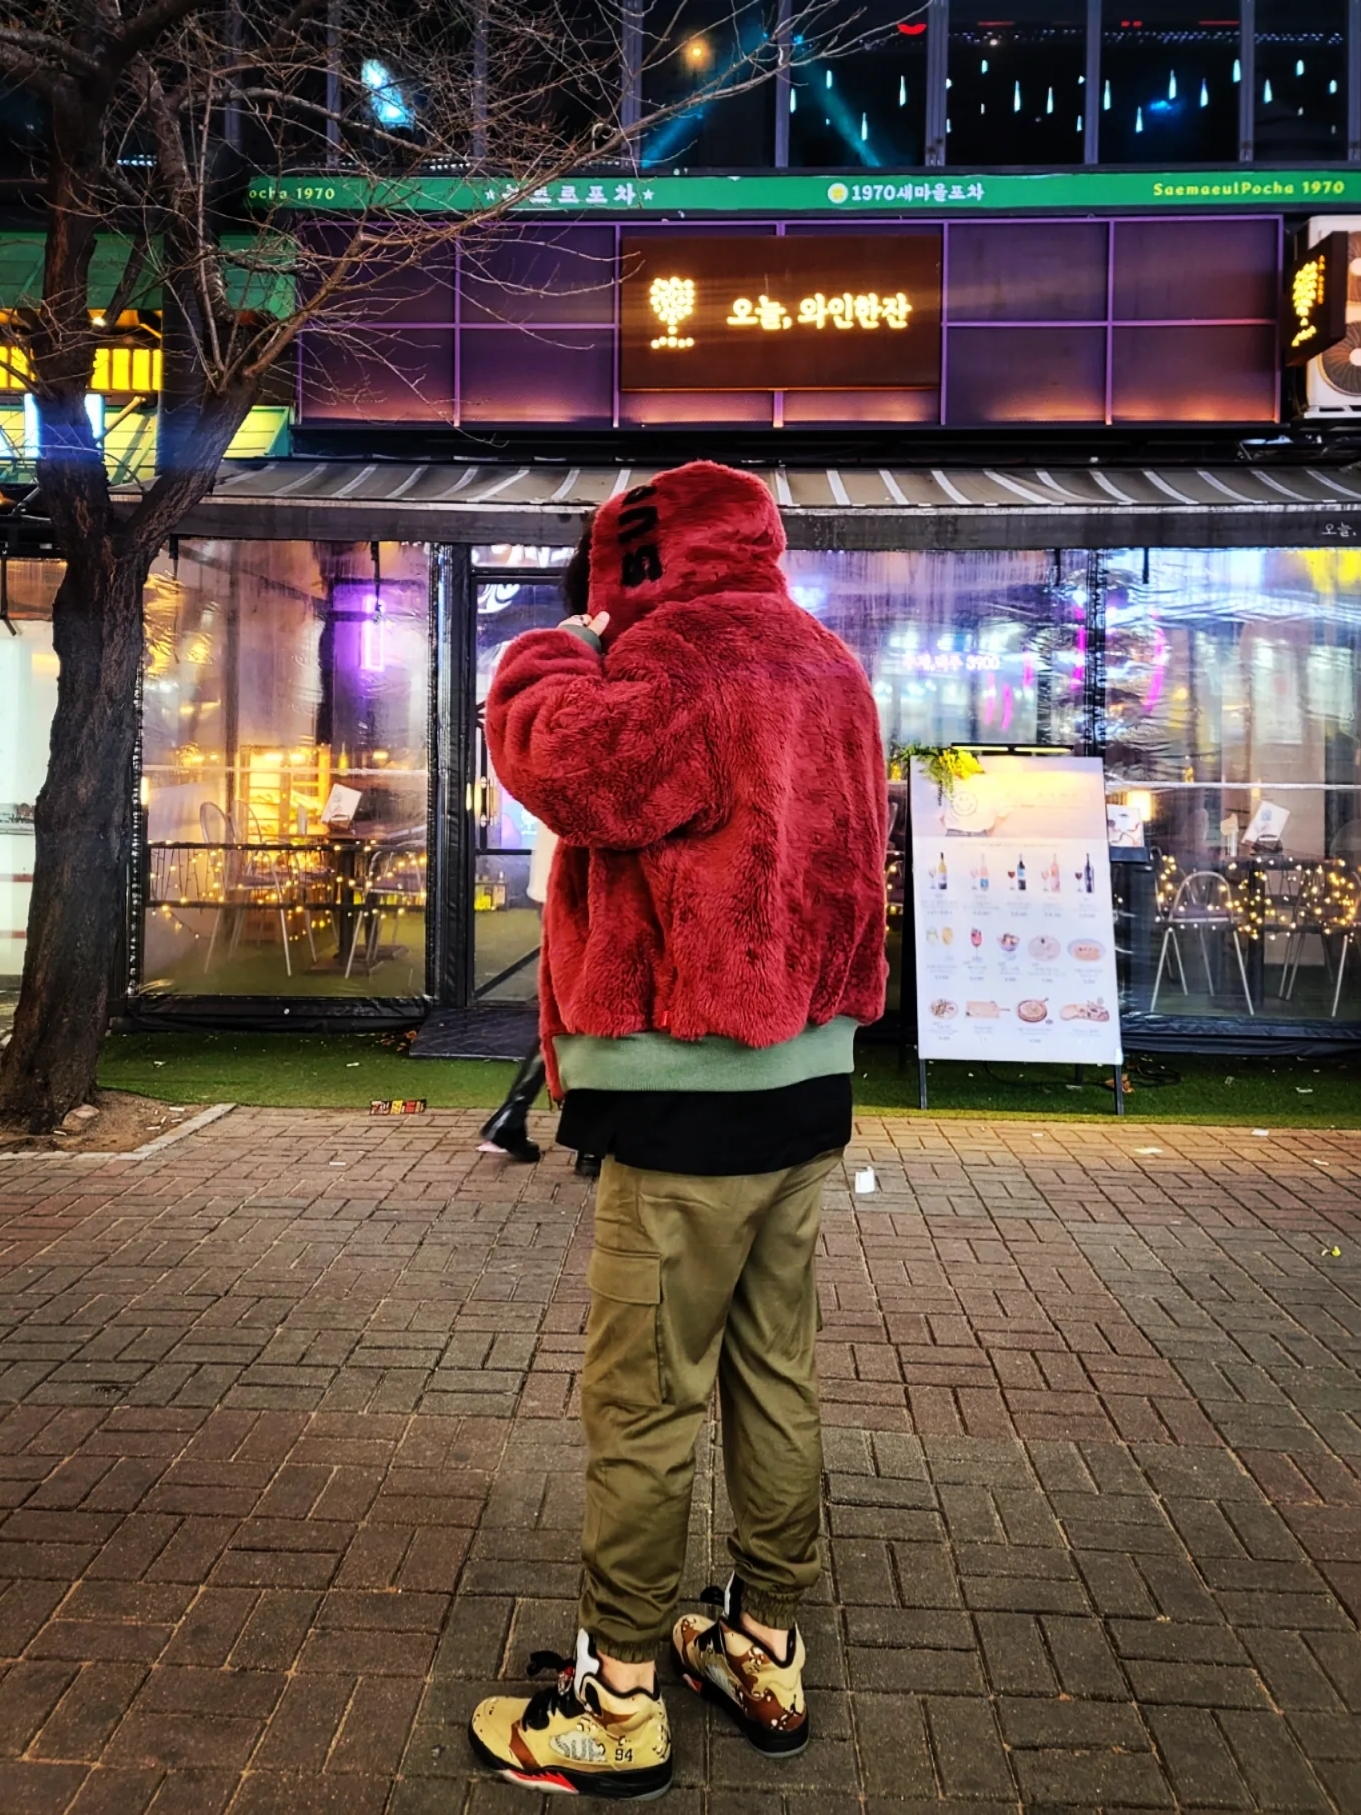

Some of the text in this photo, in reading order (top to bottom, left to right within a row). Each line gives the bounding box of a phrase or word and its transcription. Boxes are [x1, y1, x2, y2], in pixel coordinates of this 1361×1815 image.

[297, 187, 336, 200] 1970
[852, 182, 985, 202] 1970새마을포차
[1153, 180, 1345, 196] SaemaeulPocha 1970
[797, 291, 913, 330] 와인한잔
[615, 1748, 633, 1762] 94
